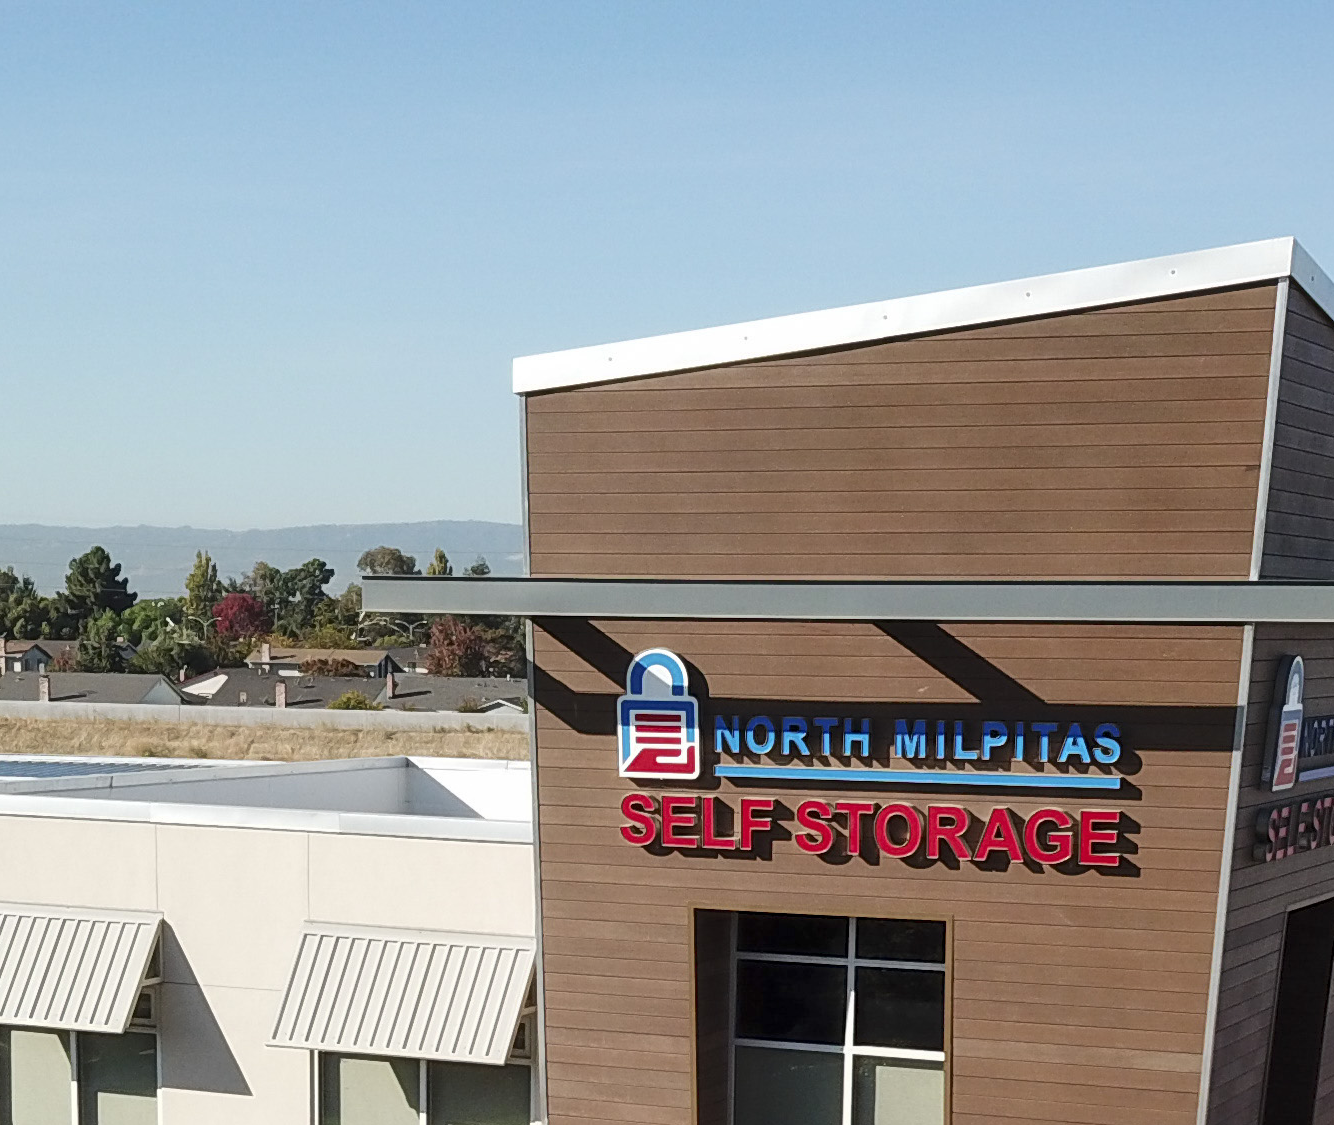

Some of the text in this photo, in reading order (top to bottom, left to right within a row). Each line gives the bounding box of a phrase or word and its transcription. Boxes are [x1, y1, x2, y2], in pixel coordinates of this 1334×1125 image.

[714, 714, 1122, 765] NORTH MILPITAS
[619, 793, 1121, 867] SELF STORAGE
